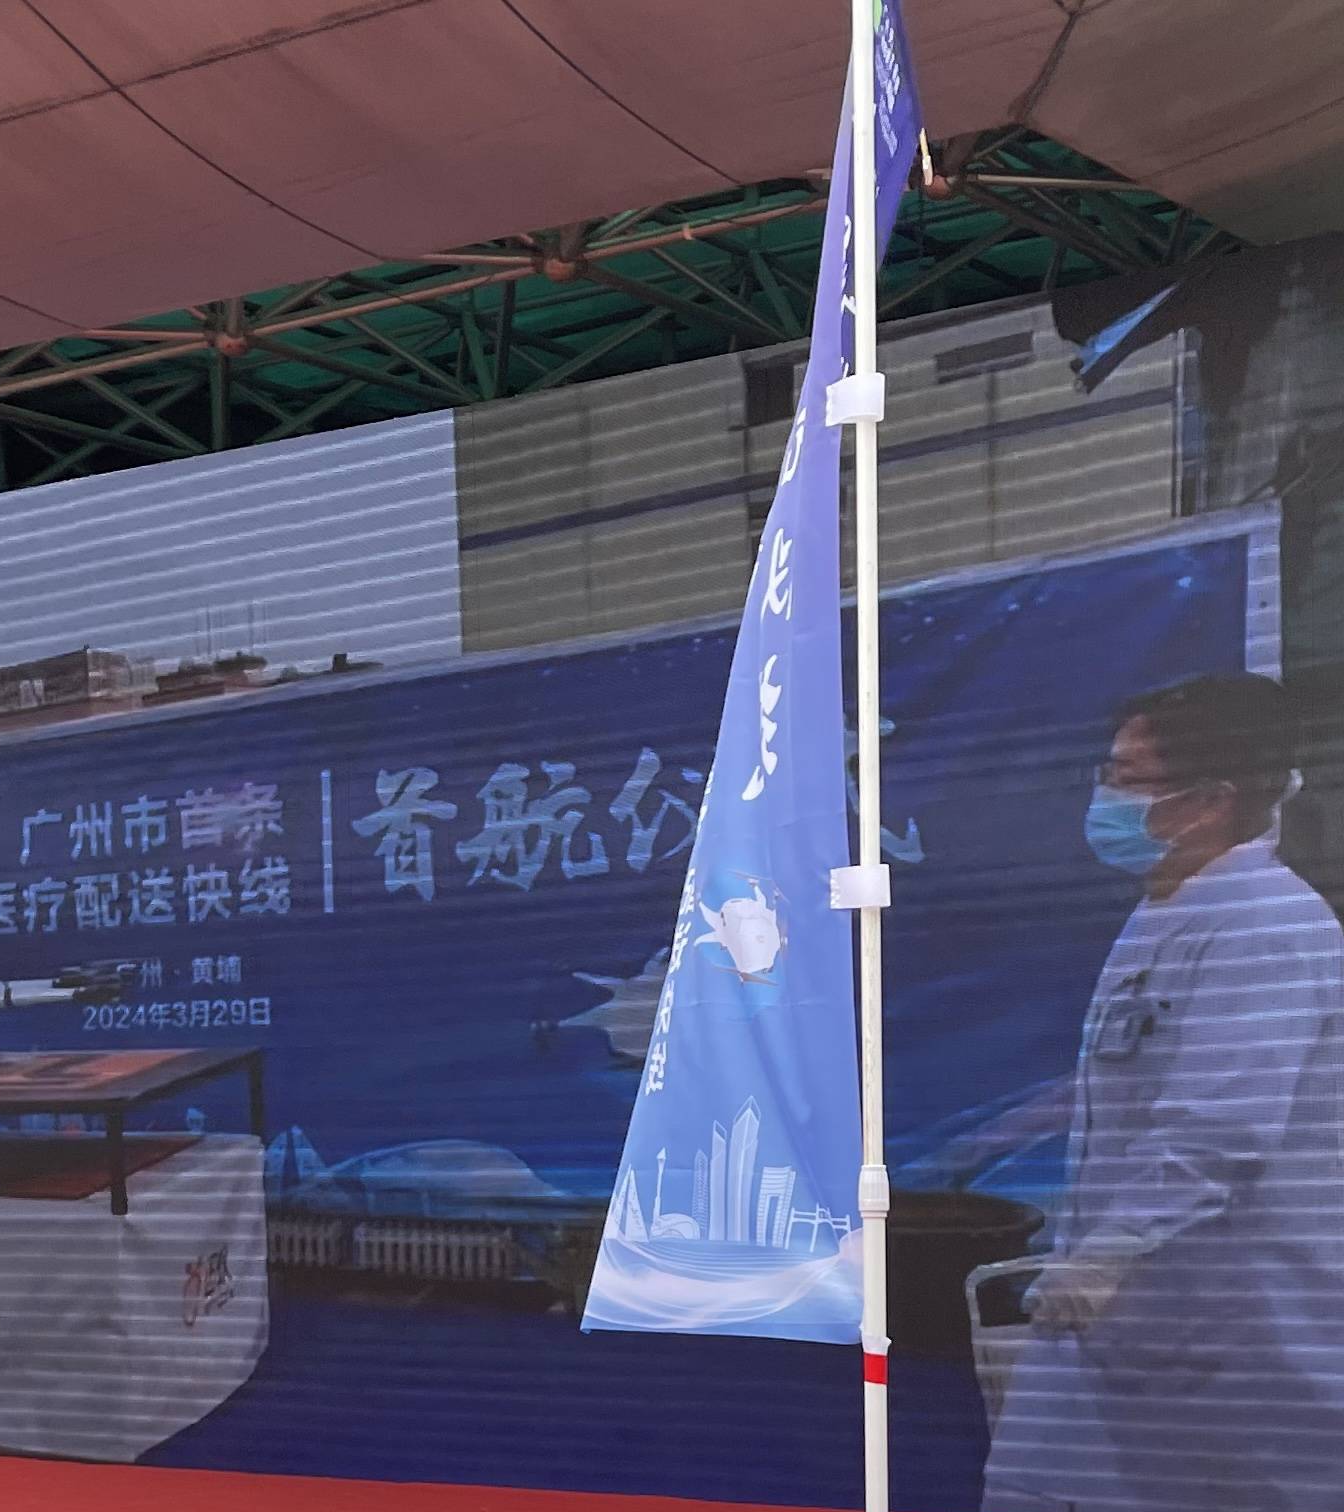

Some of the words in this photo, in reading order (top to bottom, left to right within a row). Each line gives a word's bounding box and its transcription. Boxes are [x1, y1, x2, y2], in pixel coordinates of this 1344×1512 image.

[20, 782, 284, 866] 广州市首条
[83, 997, 272, 1032] 2024年3月29日
